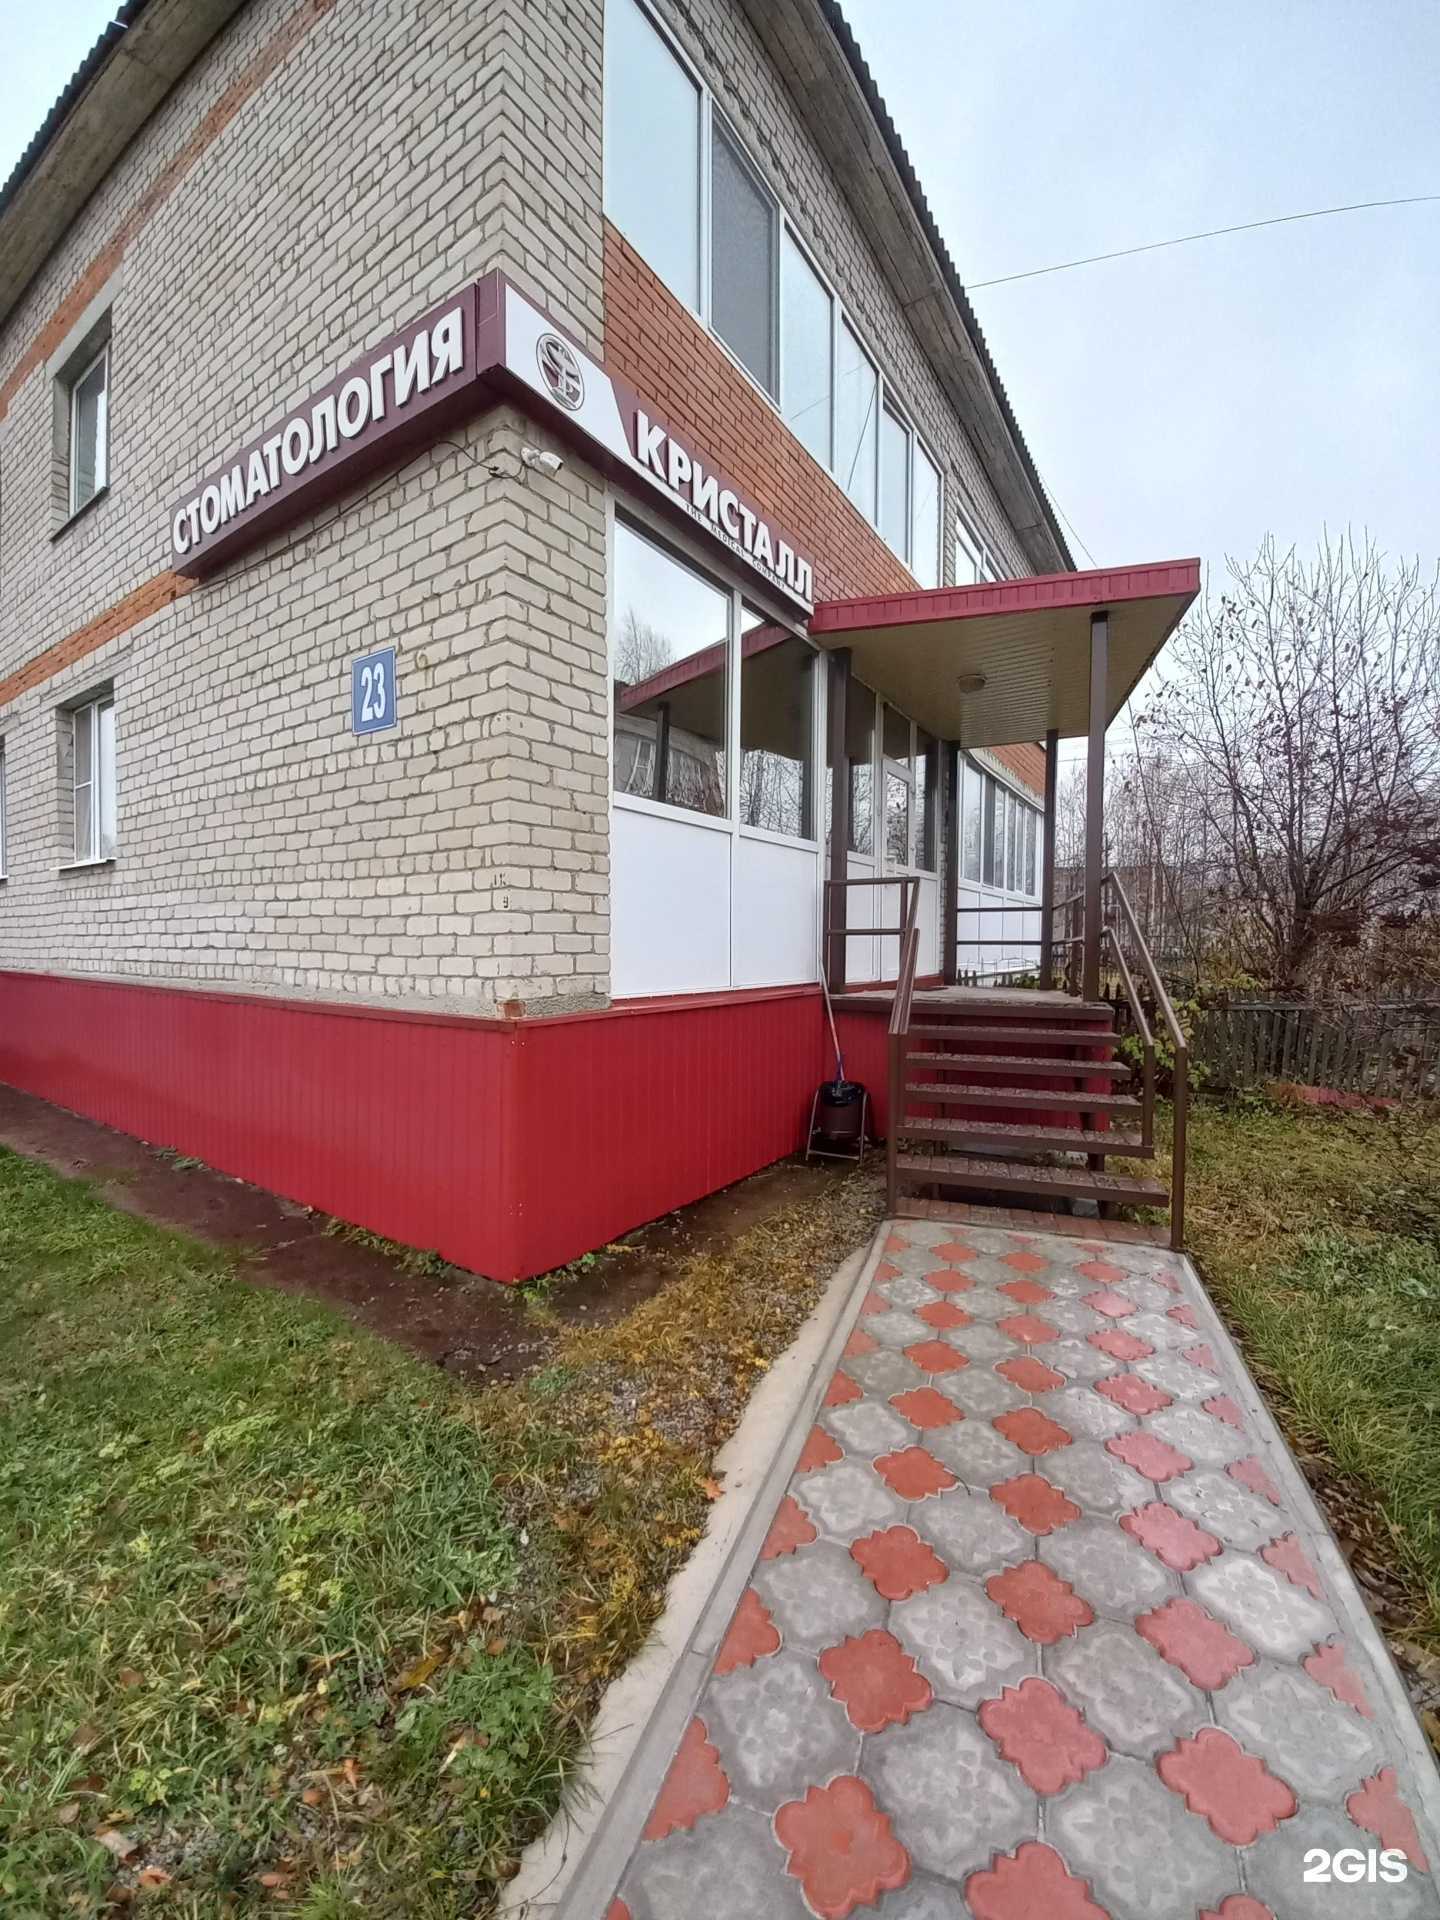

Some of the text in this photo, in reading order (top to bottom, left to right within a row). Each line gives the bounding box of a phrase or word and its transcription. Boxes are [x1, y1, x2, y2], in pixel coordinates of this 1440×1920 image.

[172, 306, 464, 554] СТОМАТОЛОГИЯ
[636, 408, 812, 603] КРИСТАЛЛ
[686, 503, 786, 590] THE MEDICAL COMPANY
[360, 662, 386, 722] 23
